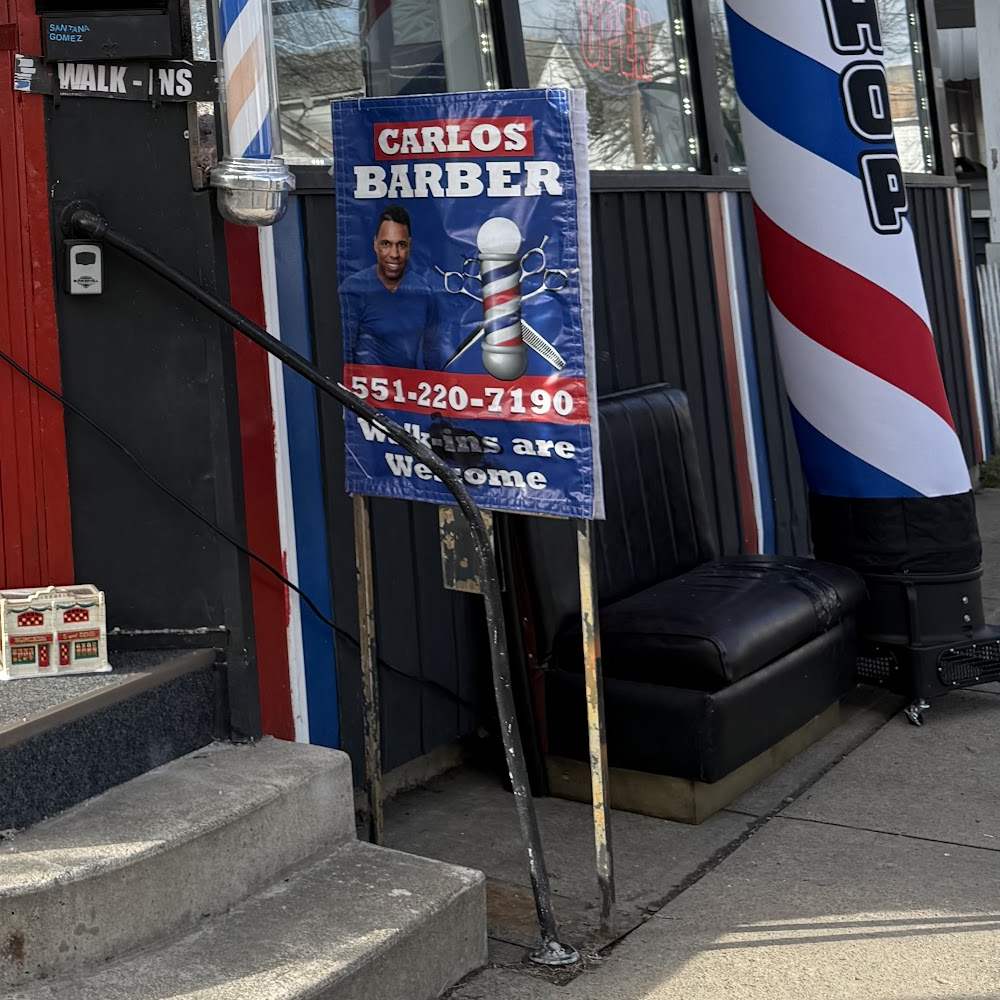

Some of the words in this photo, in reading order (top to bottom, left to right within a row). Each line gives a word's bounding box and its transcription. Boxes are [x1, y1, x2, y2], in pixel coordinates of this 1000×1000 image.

[49, 23, 91, 33] SANTANA
[49, 33, 83, 43] GOMEZ
[377, 122, 528, 155] CARLOS
[353, 160, 564, 199] BARBER
[351, 375, 574, 416] 551-220-7190
[511, 437, 576, 459] are
[384, 452, 548, 490] Weome
